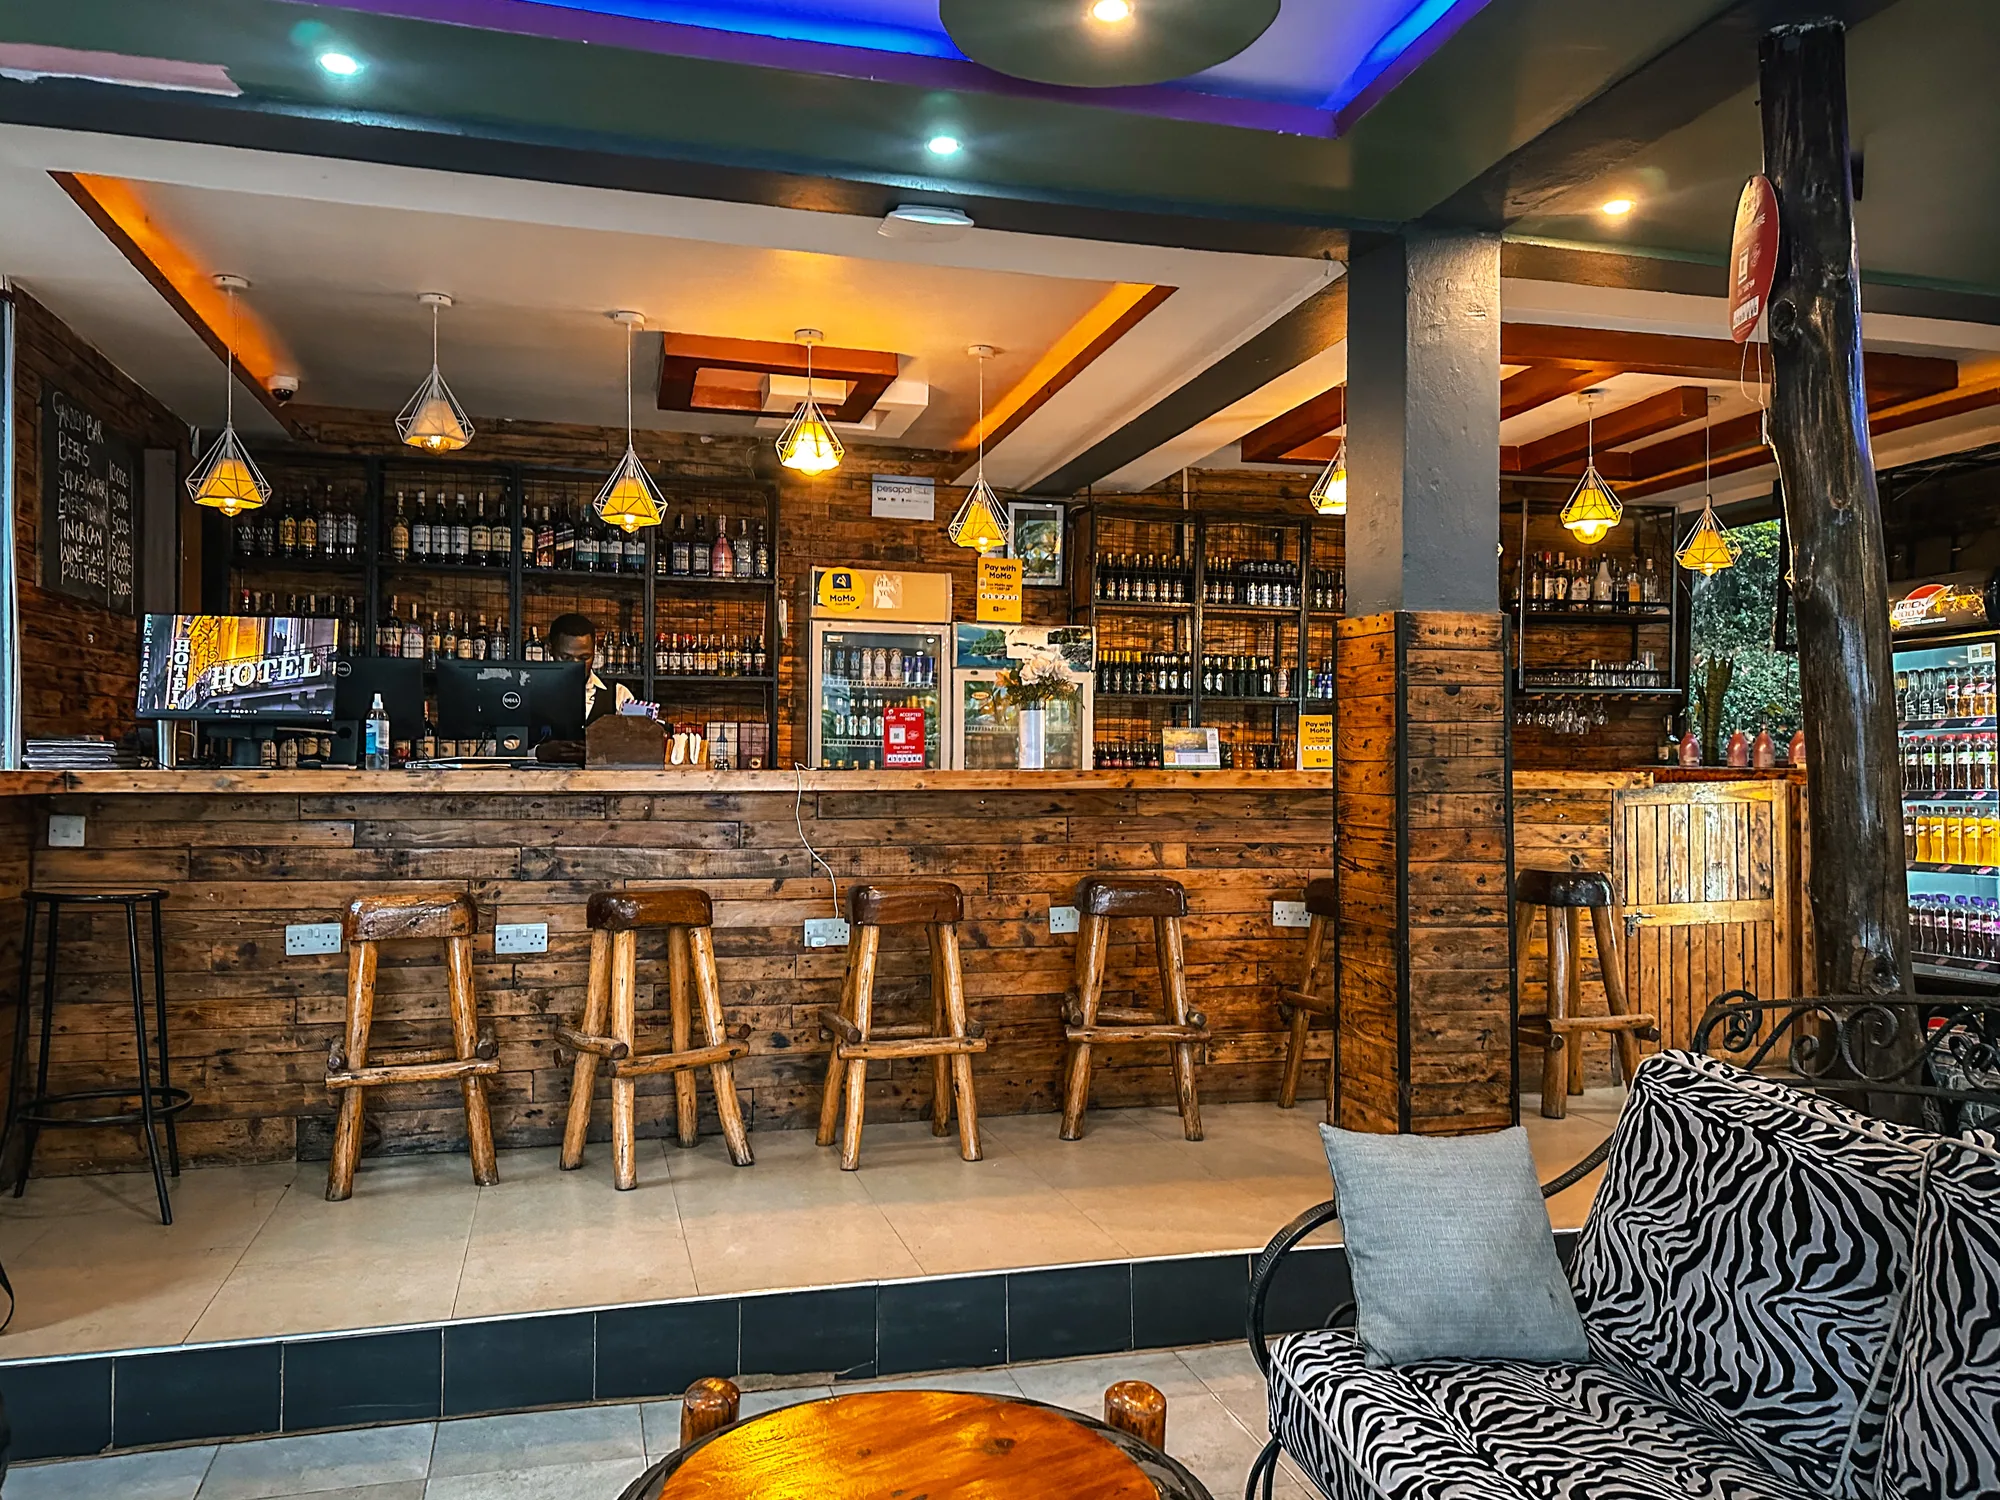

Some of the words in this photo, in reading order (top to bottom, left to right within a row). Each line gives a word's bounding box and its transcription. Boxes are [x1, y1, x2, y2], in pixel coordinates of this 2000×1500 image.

[86, 414, 104, 444] BAR
[58, 430, 90, 467] BEERS
[876, 485, 913, 495] pesapal
[58, 515, 75, 540] TIN
[86, 523, 103, 546] CAN
[60, 542, 83, 563] WINE
[984, 563, 999, 572] Pay
[989, 572, 1012, 580] MoMo
[829, 594, 856, 602] MoMo
[170, 639, 191, 710] HOTEL
[209, 653, 322, 691] HOTEL
